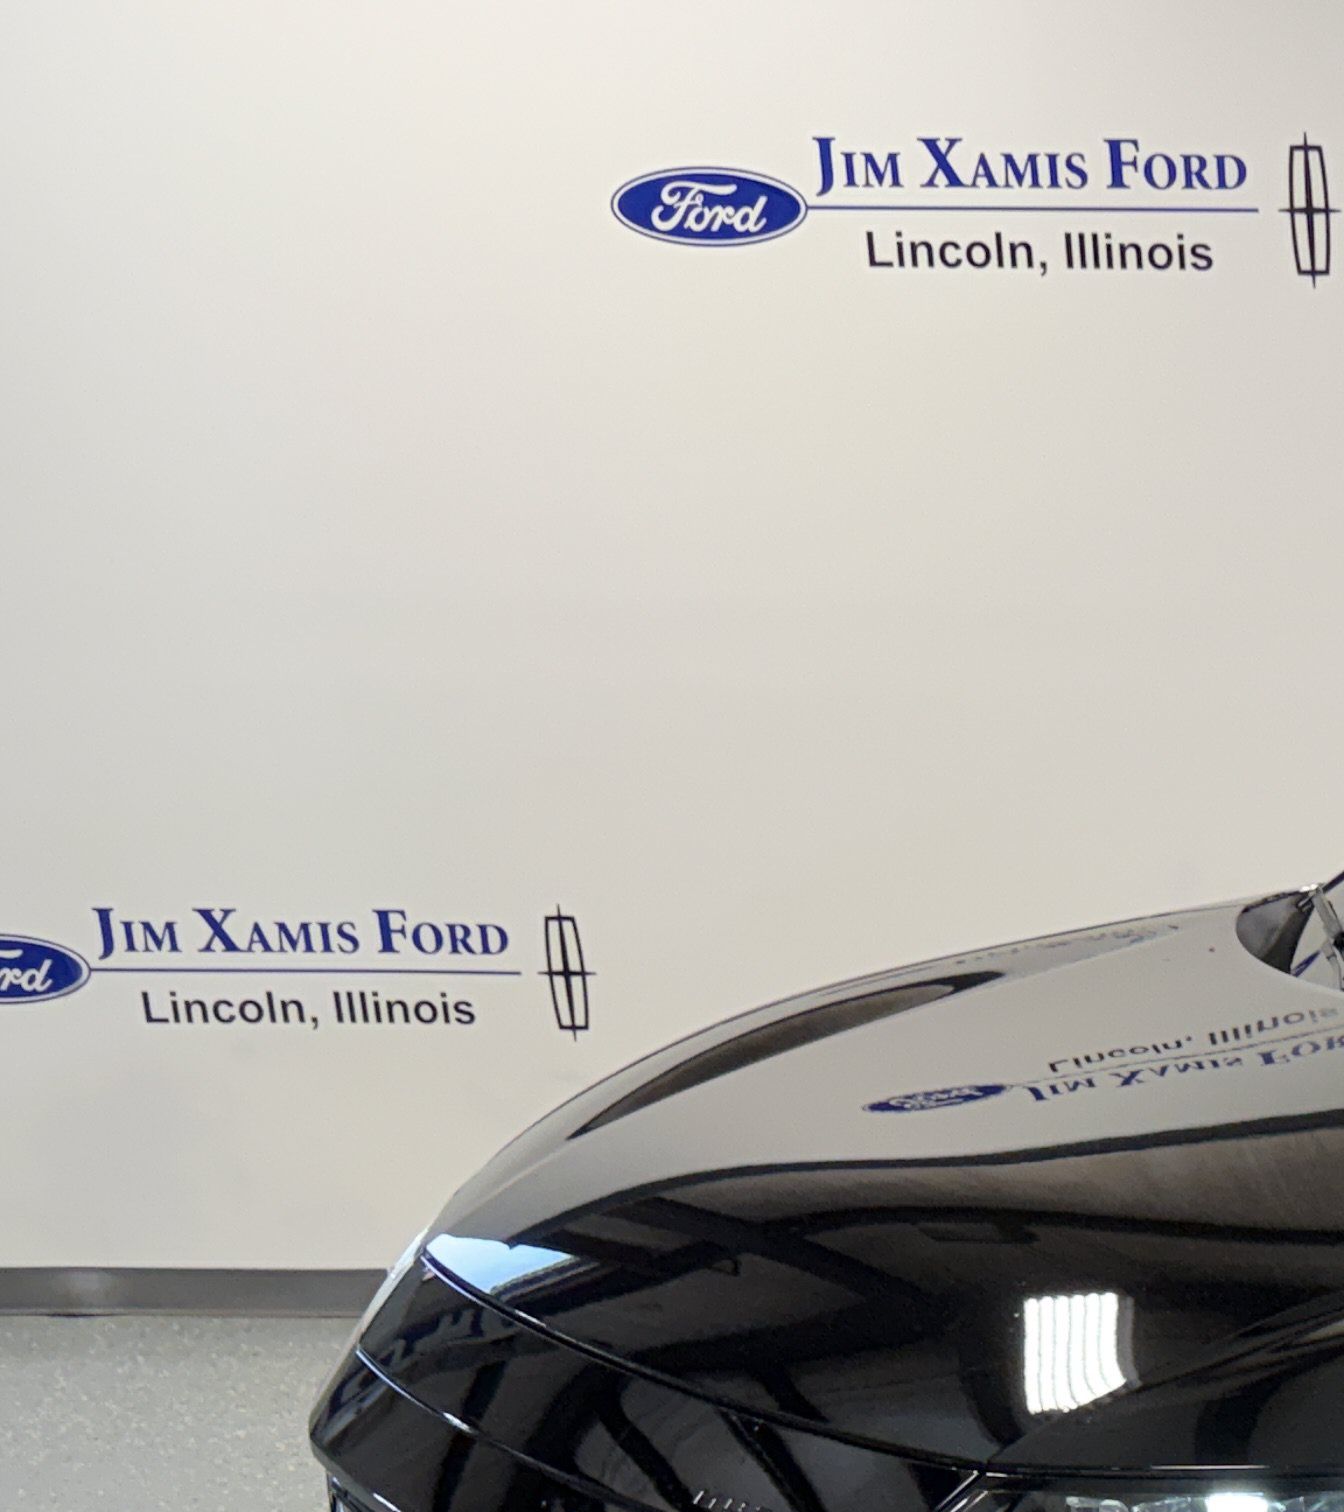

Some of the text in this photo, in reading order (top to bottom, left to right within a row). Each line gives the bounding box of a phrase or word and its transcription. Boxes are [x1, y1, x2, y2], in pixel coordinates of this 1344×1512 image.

[651, 179, 768, 235] Ford
[866, 230, 1214, 277] Lincoln, Illinois
[140, 990, 476, 1031] Lincoln, Illinois
